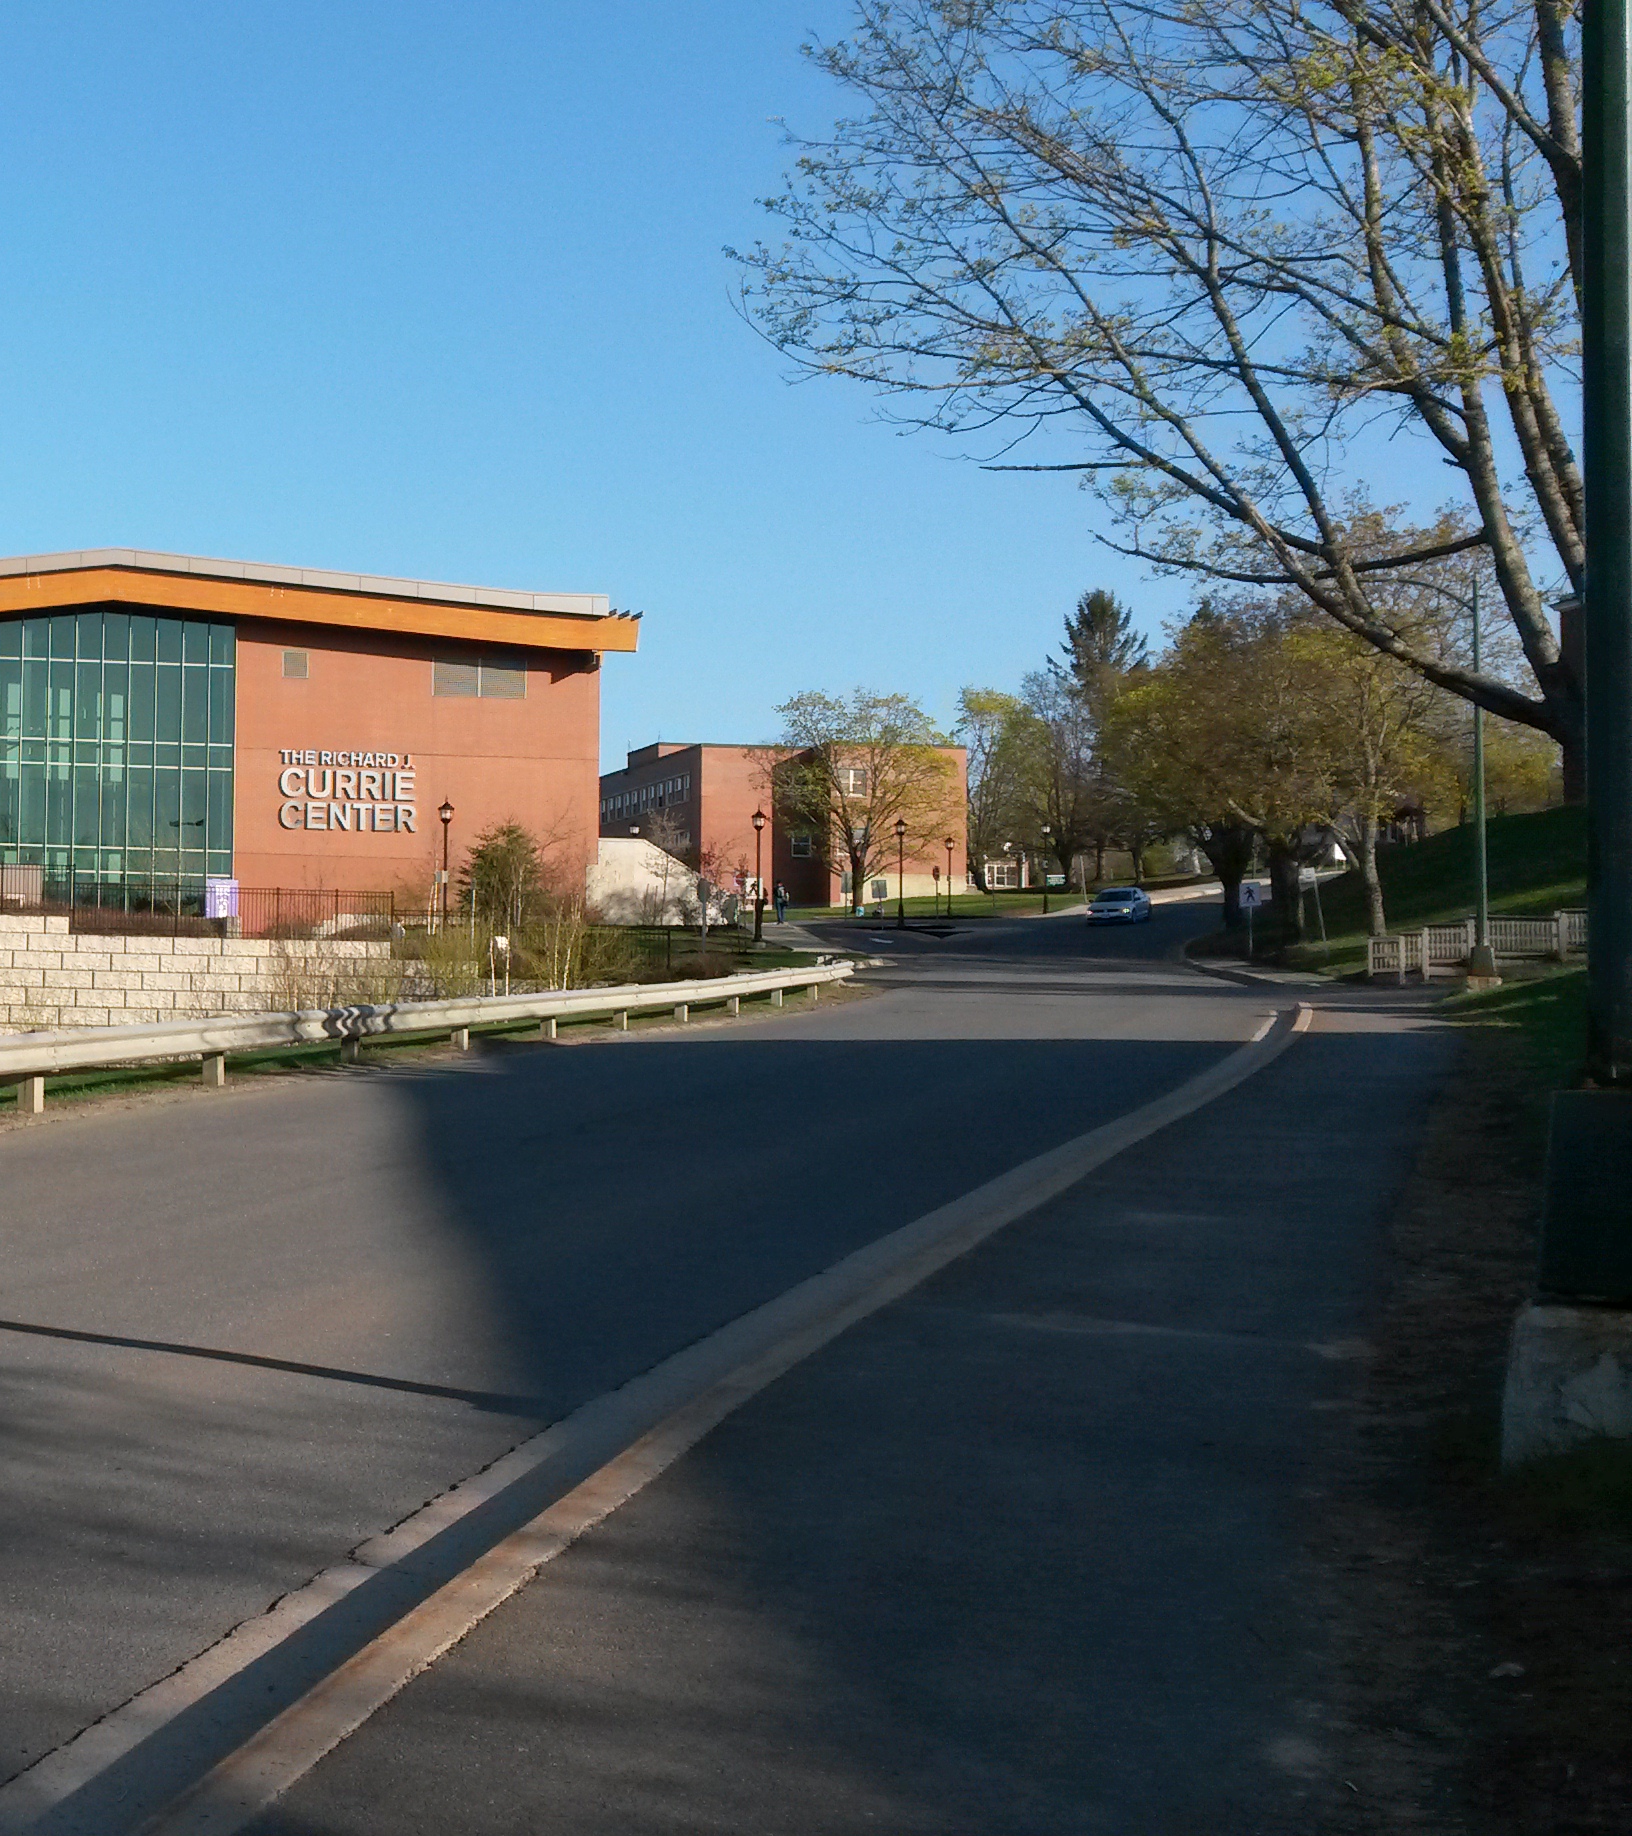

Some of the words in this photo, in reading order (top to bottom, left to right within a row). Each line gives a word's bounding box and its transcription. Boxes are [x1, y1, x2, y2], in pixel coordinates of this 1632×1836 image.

[280, 750, 316, 765] THE
[319, 751, 399, 768] RICHARD
[401, 754, 416, 769] J.
[279, 767, 416, 801] CURRIE
[279, 801, 417, 833] CENTER
